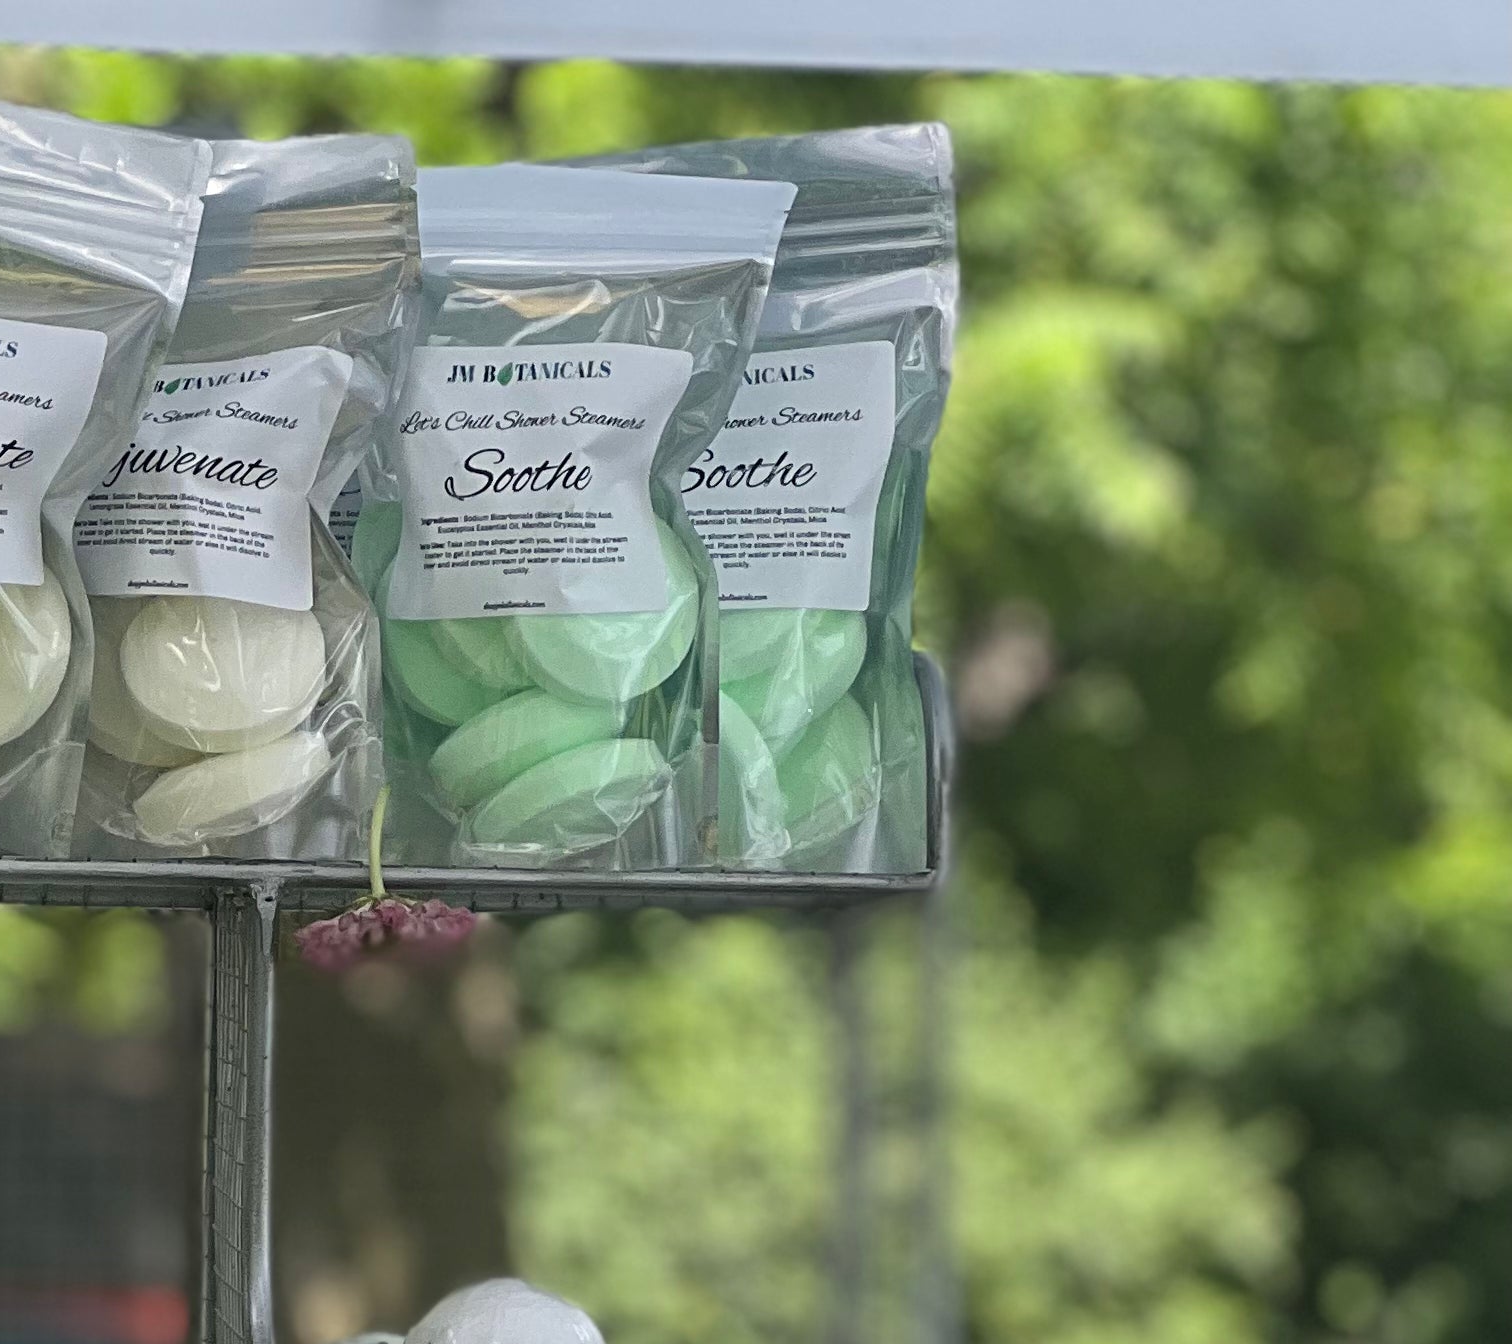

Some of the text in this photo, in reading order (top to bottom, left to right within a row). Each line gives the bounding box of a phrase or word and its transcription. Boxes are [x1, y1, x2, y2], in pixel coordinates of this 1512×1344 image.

[446, 364, 476, 384] JM
[215, 401, 299, 431] Steamers
[445, 412, 494, 432] Chill
[495, 410, 558, 431] Shower
[561, 406, 647, 430] Steamers
[771, 407, 863, 426] Steamers
[102, 442, 279, 490] juvenate
[444, 448, 592, 501] Soothe
[681, 449, 817, 493] Soothe
